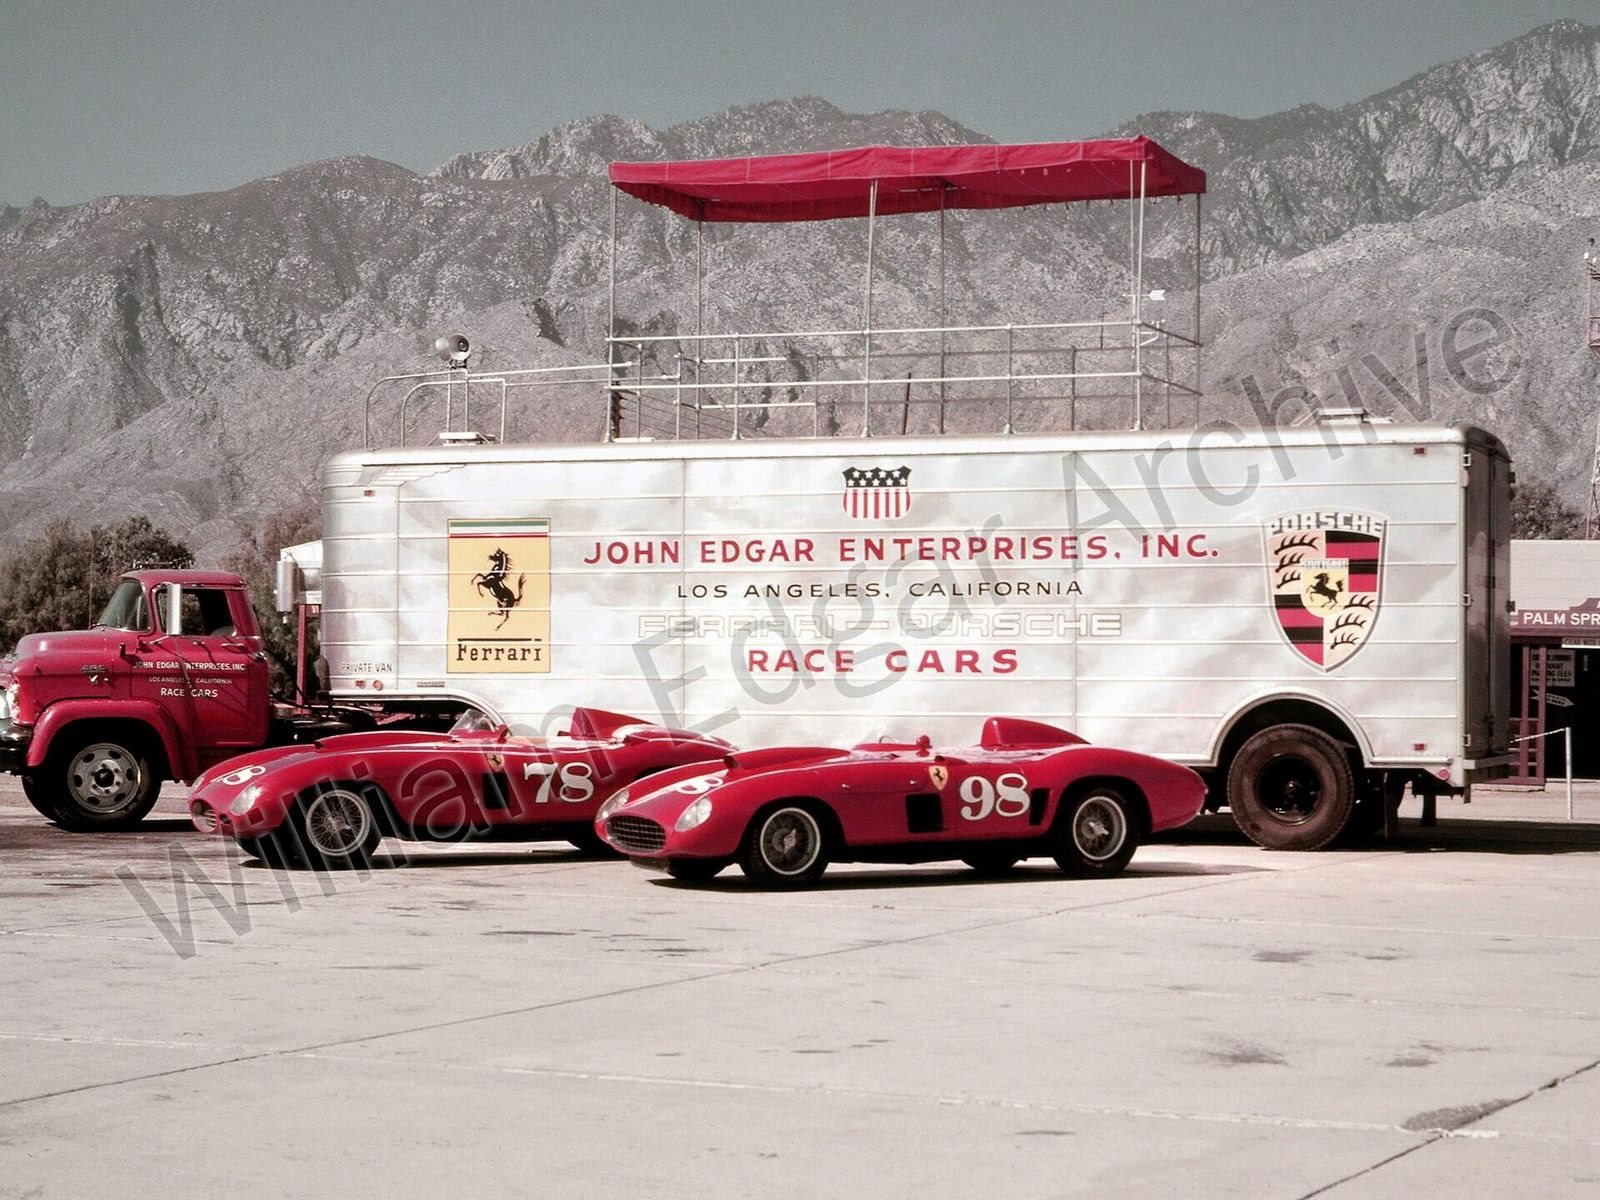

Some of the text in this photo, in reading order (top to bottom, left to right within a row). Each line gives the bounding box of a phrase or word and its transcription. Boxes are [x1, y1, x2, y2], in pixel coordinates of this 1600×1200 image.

[1268, 511, 1384, 535] PORSCHE
[583, 541, 681, 565] JOHN
[700, 539, 815, 563] EDGAR
[1142, 533, 1219, 559] INC.
[677, 584, 728, 598] LOS
[909, 580, 1083, 597] CALIFORNIA
[637, 614, 835, 639] FERRARI
[900, 612, 1122, 638] PORSCHE
[1523, 612, 1600, 625] PALM SPR
[456, 638, 543, 661] Ferrari
[748, 649, 1019, 673] RACE CARS
[133, 661, 154, 669] JOHN
[156, 661, 180, 669] EDGAR
[342, 662, 393, 673] PRIVATE VAN
[160, 687, 218, 698] RACE CARS
[523, 761, 595, 803] 78
[959, 772, 1031, 821] 98
